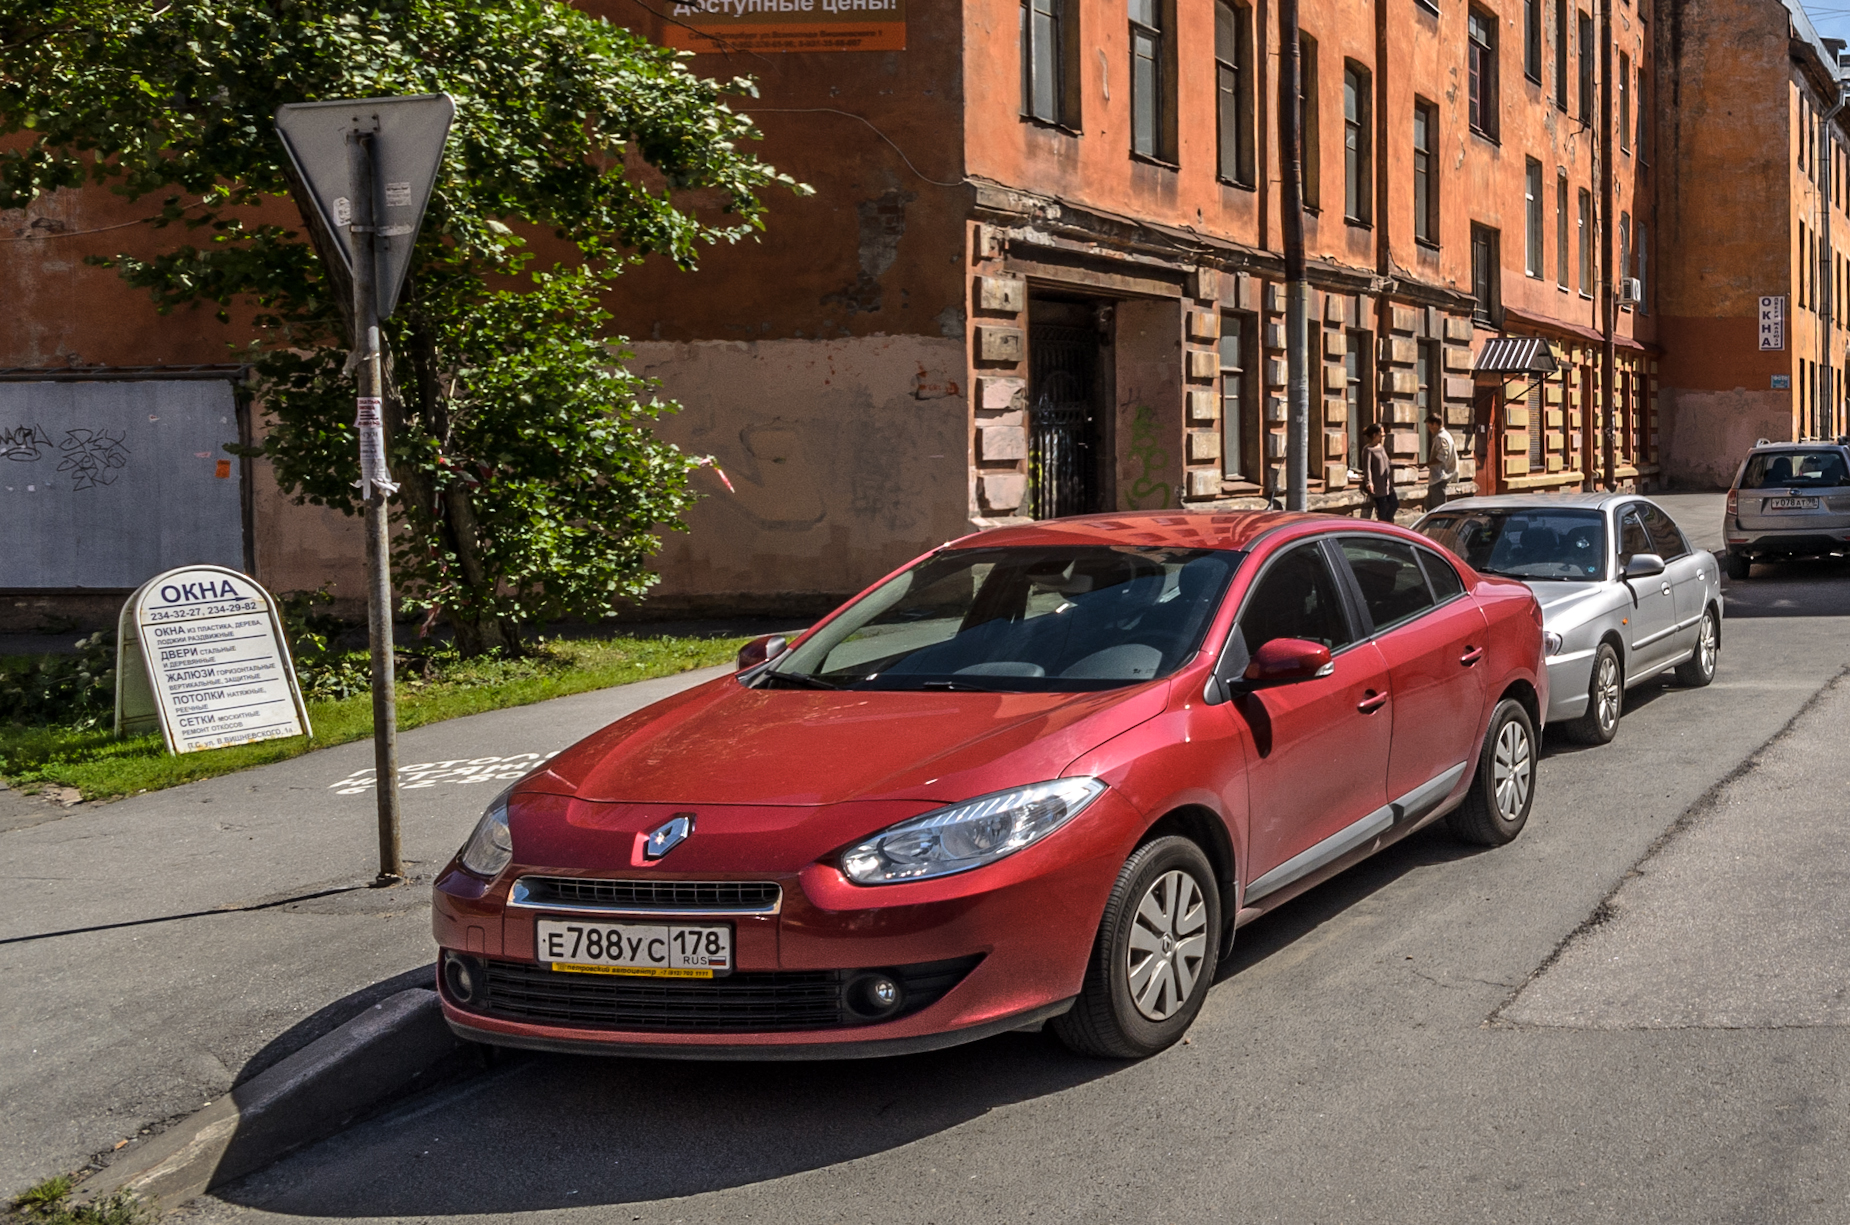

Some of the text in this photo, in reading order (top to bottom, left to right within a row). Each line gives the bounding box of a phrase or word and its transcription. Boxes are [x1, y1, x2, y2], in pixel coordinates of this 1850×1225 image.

[1761, 297, 1772, 347] ОКНА
[161, 580, 239, 603] ОКНА
[151, 602, 257, 621] 234-32-27, 234-29-82
[154, 626, 186, 637] ОКНА
[188, 631, 234, 641] РАЗДВИЖНЫЕ
[161, 646, 236, 661] ДВЕРИ СТАЛЬНЫЕ
[169, 657, 216, 668] ДЕРЕВЯННЫЕ
[166, 663, 276, 682] ЖАЛЮЗИ ГОРИЗОНТАЛЬНЫЕ
[224, 674, 261, 683] ЗАЩИТНЫЕ
[173, 691, 225, 705] ПОТОЛКИ
[175, 704, 209, 713] РЕЕЧНЫЕ
[179, 710, 260, 727] СЕТКИ МОСКИТНЫЕ
[182, 722, 243, 736] РЕМОНТ ОТКОСОВ
[548, 926, 720, 962] Е788УС 178
[683, 955, 707, 965] RUS
